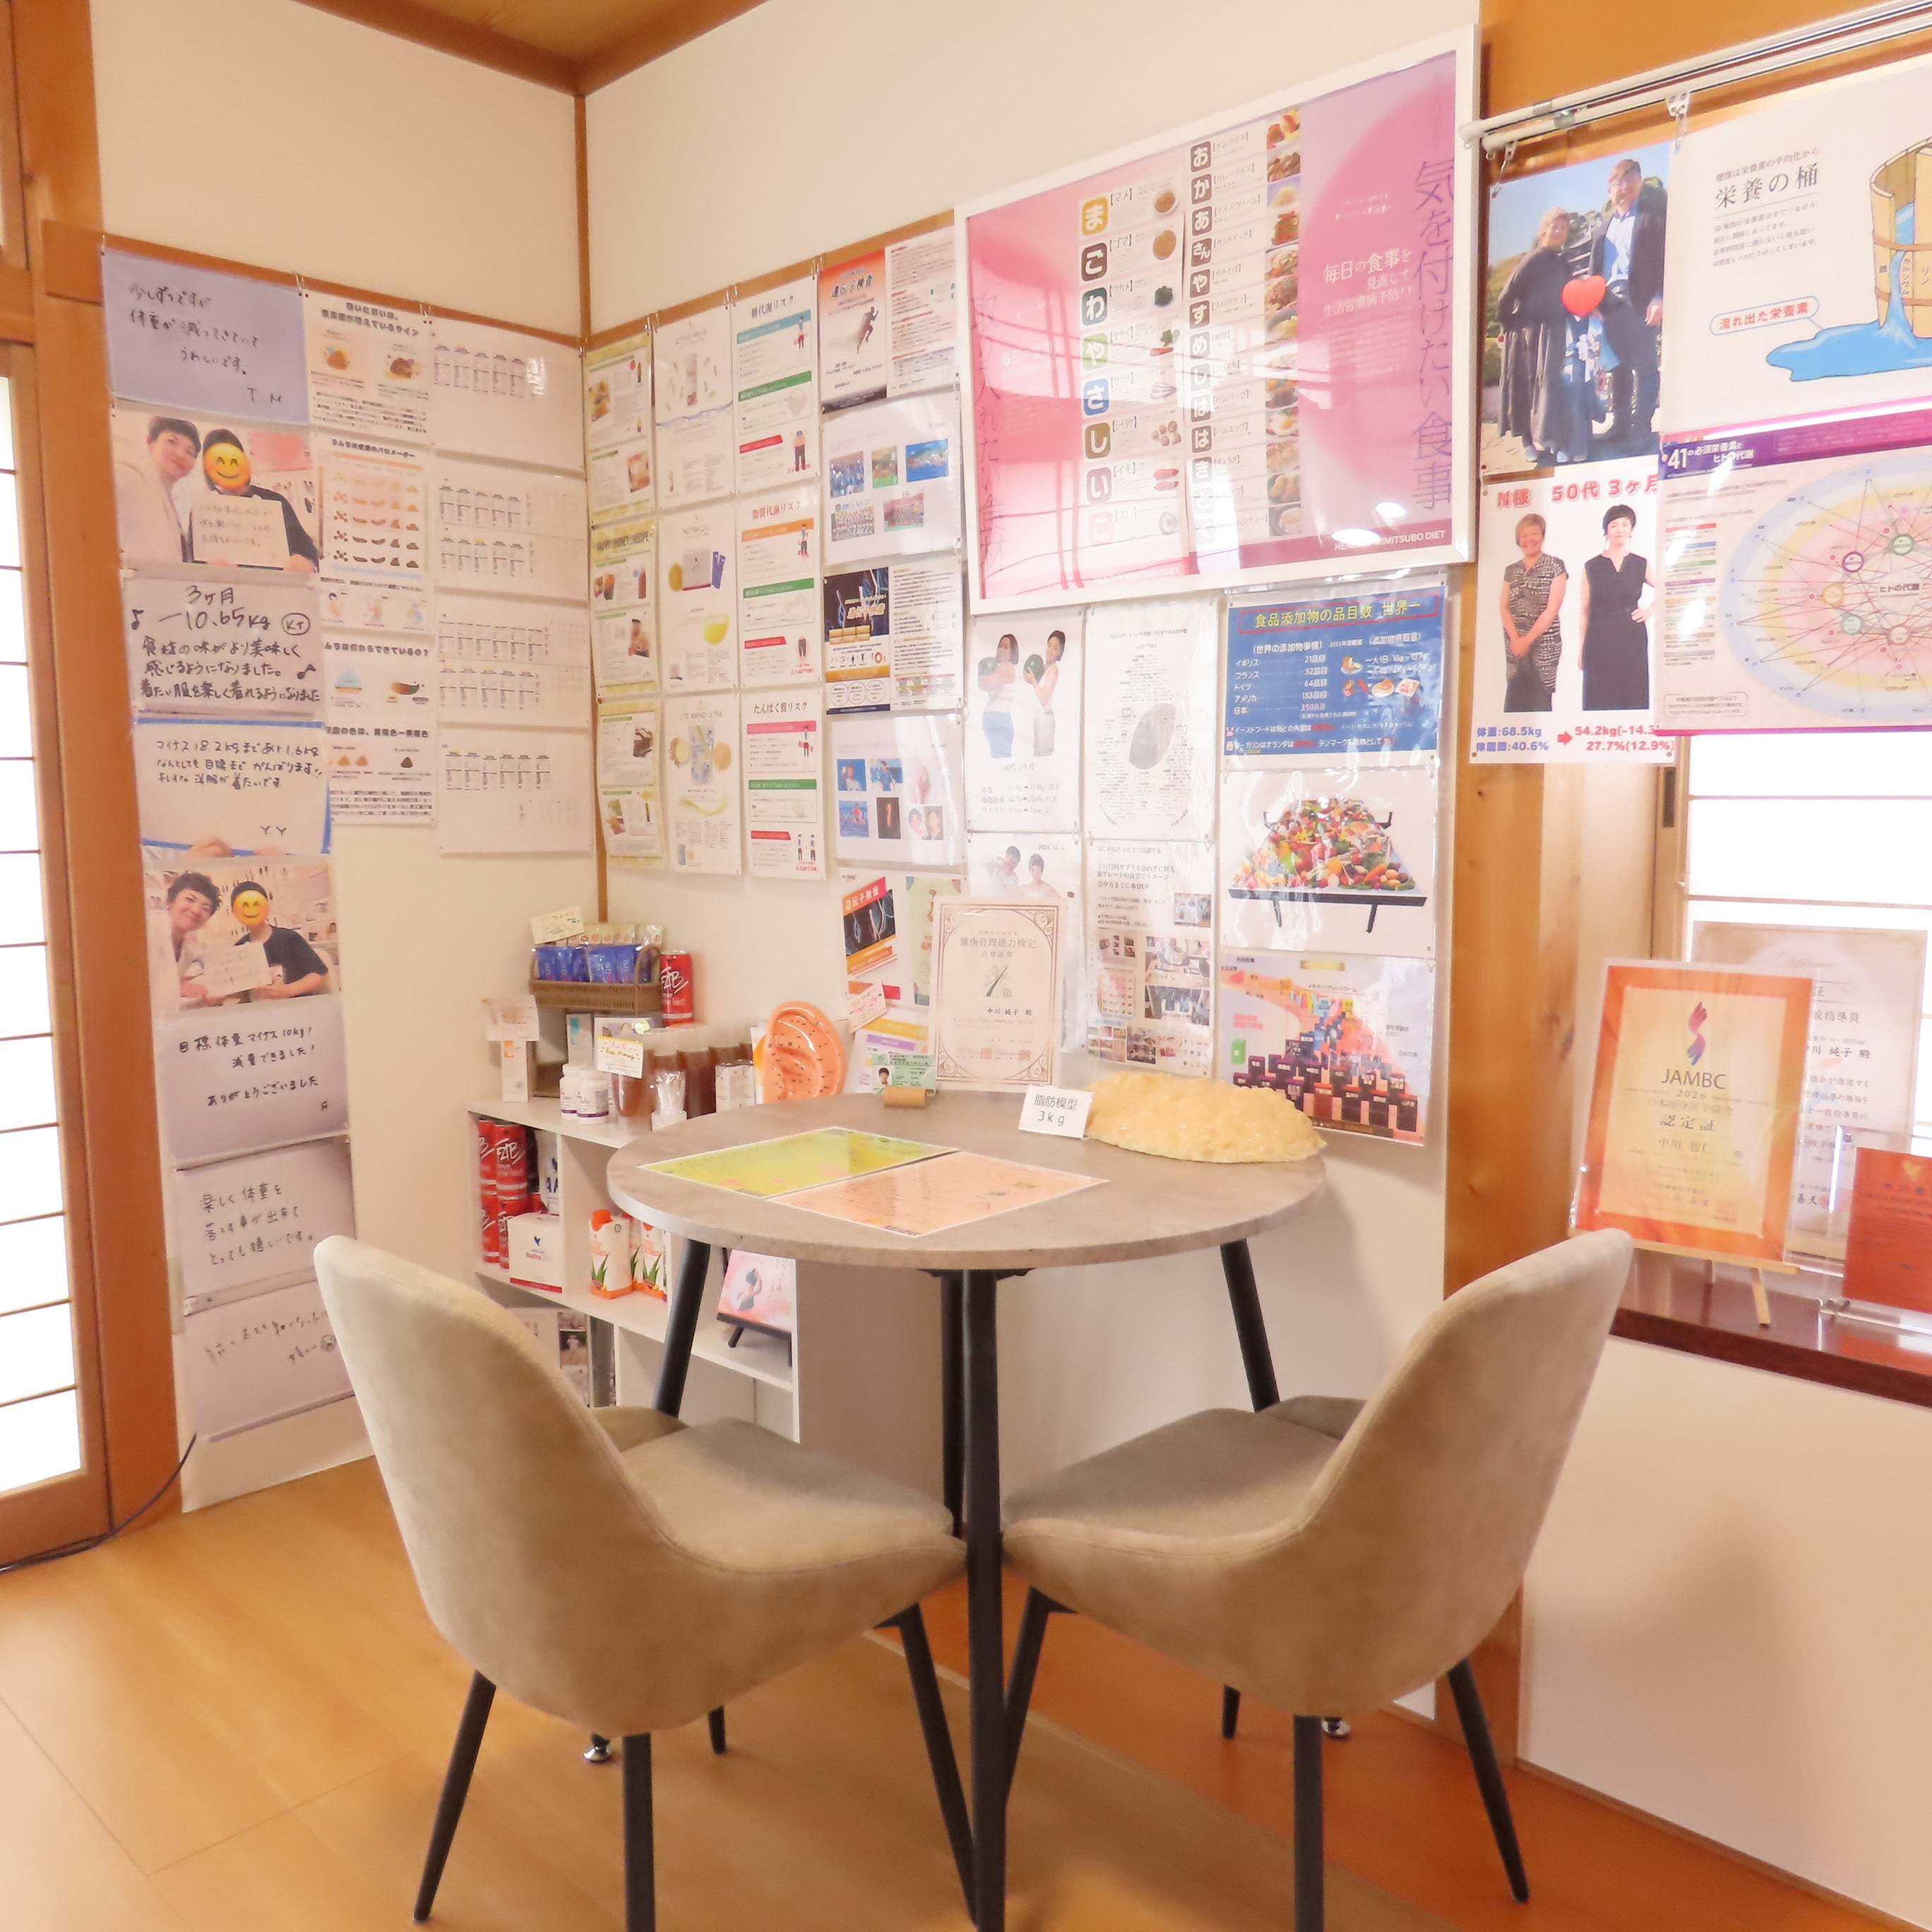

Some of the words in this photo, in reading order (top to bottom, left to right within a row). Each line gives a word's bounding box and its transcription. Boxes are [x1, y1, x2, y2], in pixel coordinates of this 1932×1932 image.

[1193, 146, 1209, 168] お
[1193, 177, 1210, 199] か
[1715, 162, 1818, 210] 栄養の桶
[1085, 204, 1104, 231] ま
[1195, 210, 1210, 231] あ
[1193, 242, 1210, 260] さん
[1193, 273, 1208, 292] や
[1085, 295, 1104, 321] わ
[1192, 304, 1208, 325] す
[1718, 301, 1810, 331] 流れ出た栄養素
[1413, 157, 1455, 511] 気を付けたい食事
[1085, 340, 1105, 366] や
[1086, 383, 1106, 410] さ
[1090, 436, 1107, 453] し
[1194, 429, 1209, 449] は
[1091, 475, 1109, 496] い
[1551, 481, 1600, 502] 50代
[1425, 530, 1445, 540] DIET
[1255, 604, 1373, 628] 食品添加物の品目数
[1382, 600, 1421, 616] 世界一
[753, 700, 808, 715] たんぱく質リスク
[1234, 706, 1248, 715] 日本
[960, 937, 1036, 950] 健康管理能力検定
[1661, 1068, 1728, 1090] JAMBC
[207, 1075, 318, 1107] ありがとうございました
[1677, 1090, 1705, 1100] 2026
[1033, 1094, 1078, 1111] 脂肪模型
[1037, 1110, 1066, 1126] 3kg
[1659, 1114, 1716, 1132] 認定証
